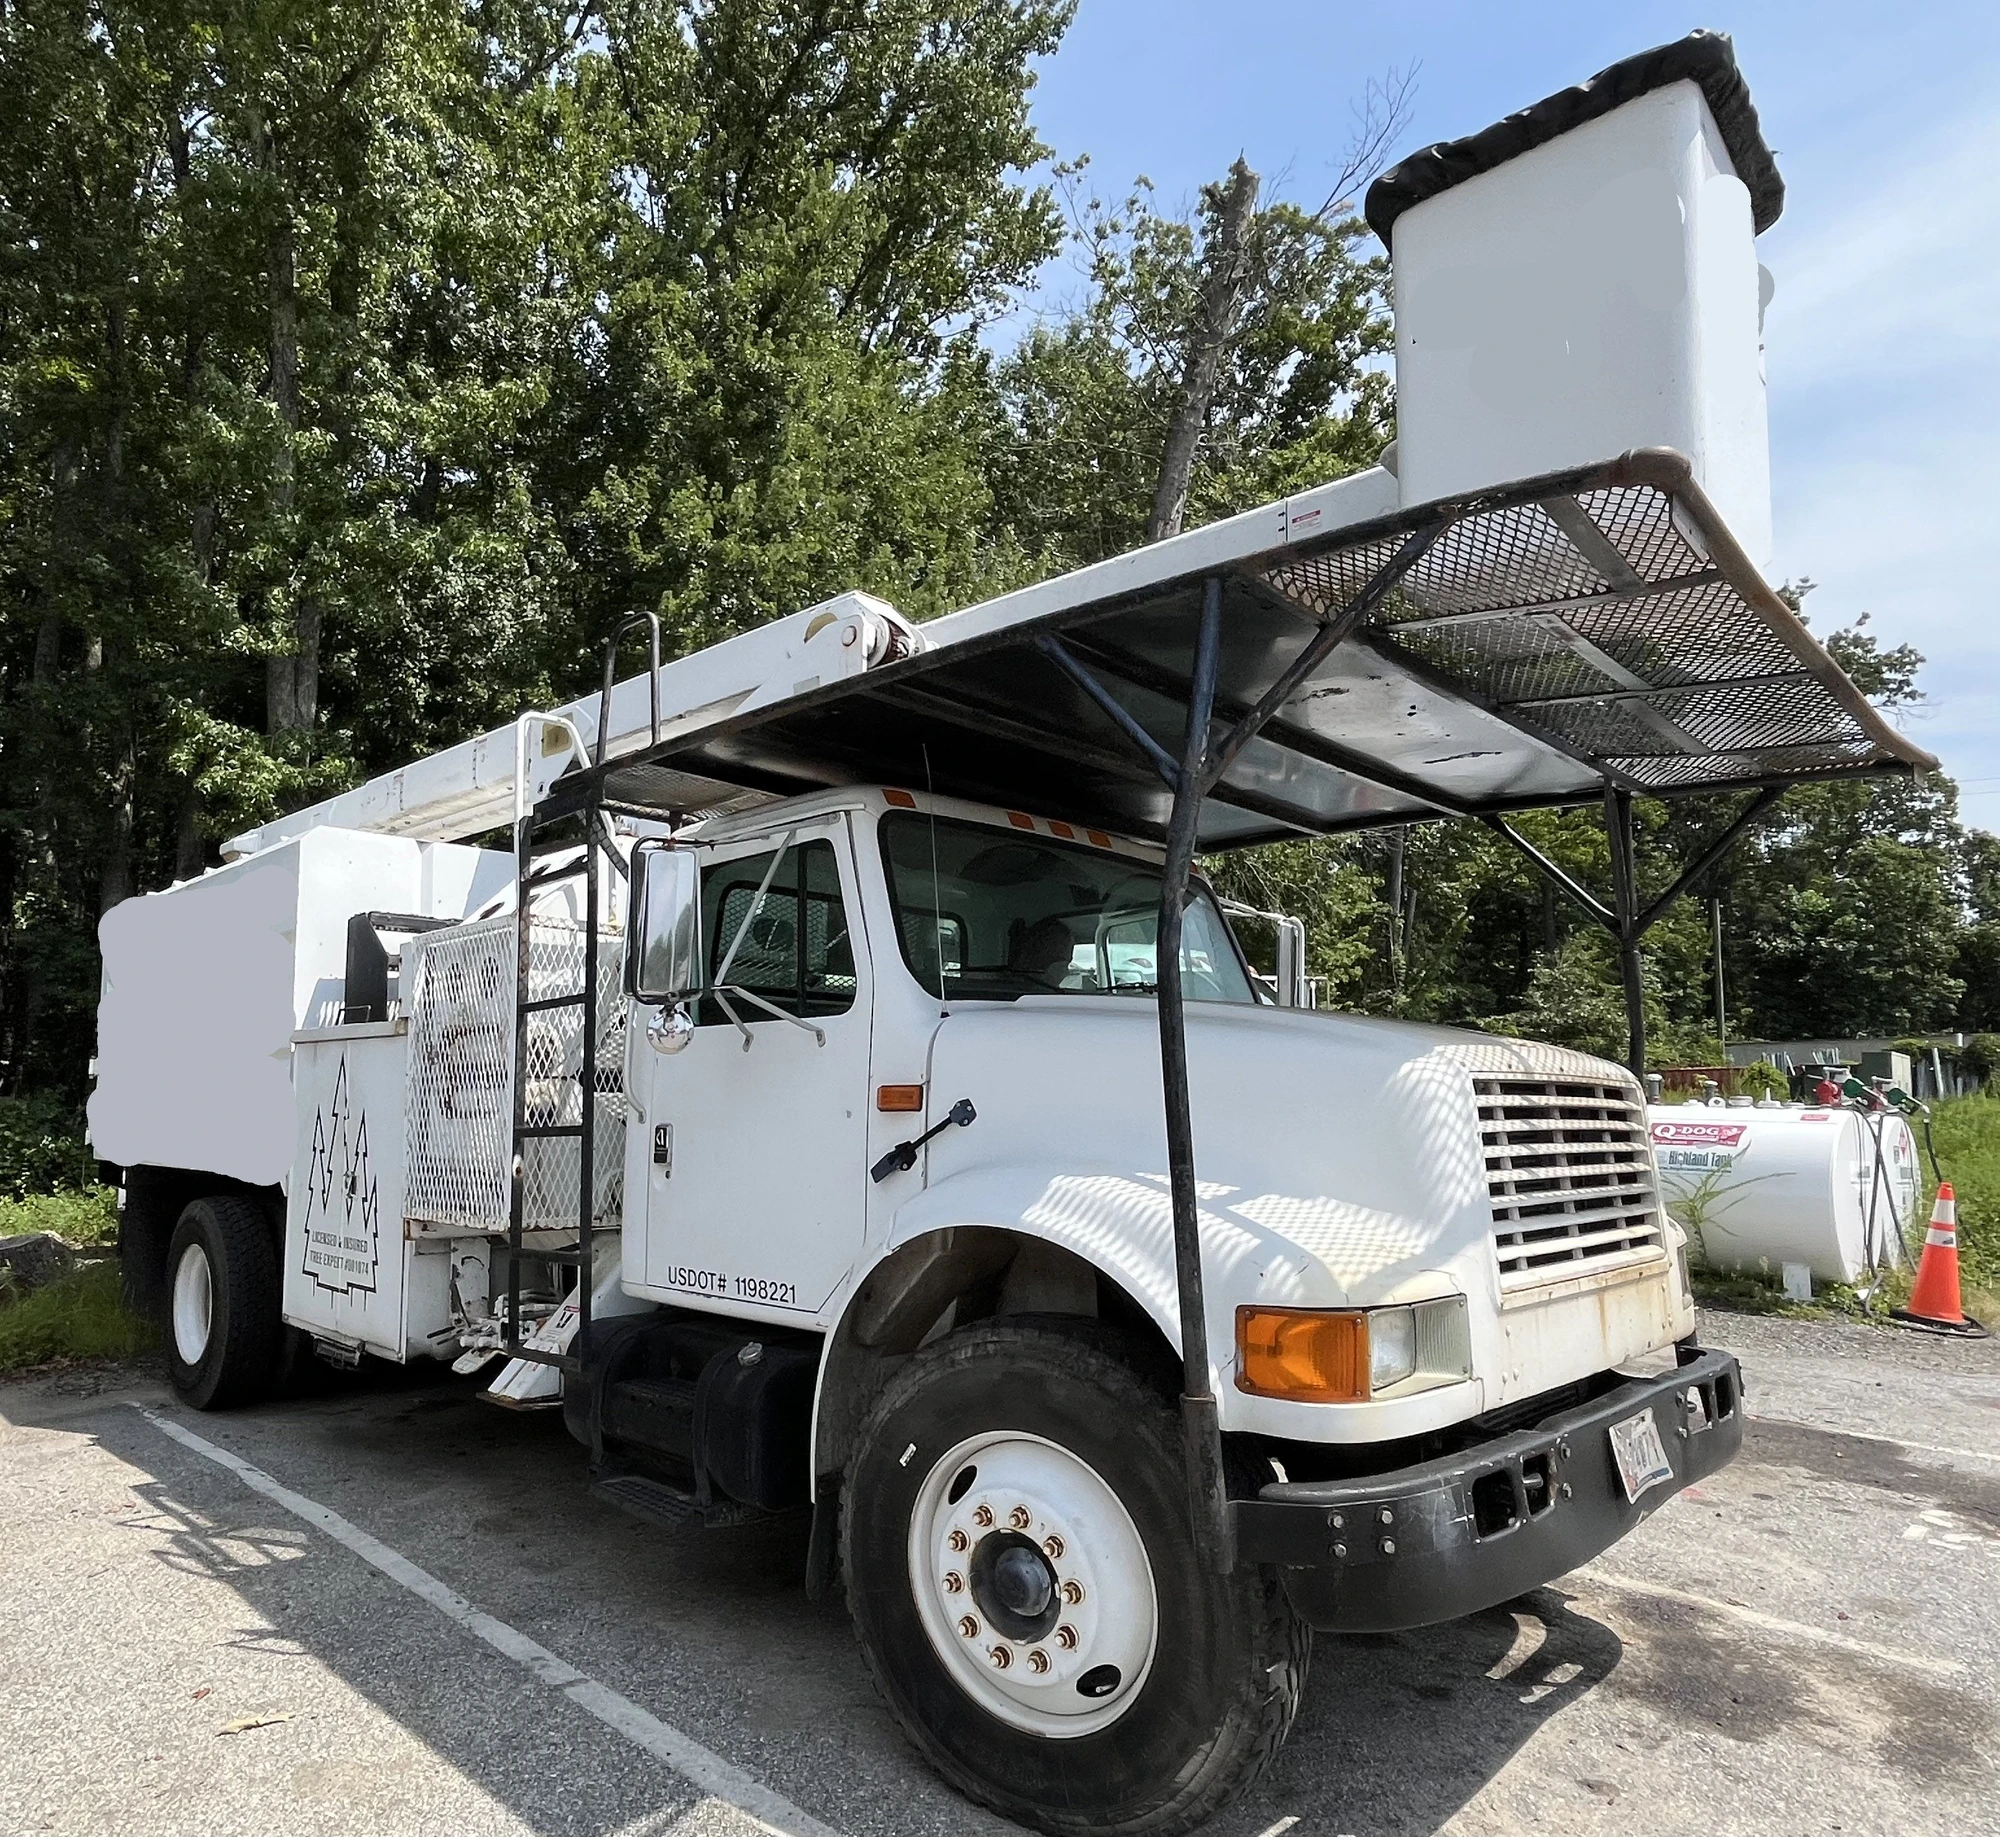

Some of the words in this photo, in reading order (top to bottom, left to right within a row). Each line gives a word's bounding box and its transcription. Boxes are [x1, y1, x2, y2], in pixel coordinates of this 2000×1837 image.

[1654, 1124, 1719, 1139] Q-DOG
[1668, 1150, 1709, 1167] Highland
[312, 1230, 337, 1247] LICENSED
[343, 1236, 368, 1253] INSURED
[310, 1250, 322, 1265] TREE
[323, 1253, 344, 1269] EXPERT
[668, 1265, 727, 1292] USDOT#
[735, 1276, 796, 1304] 1198221
